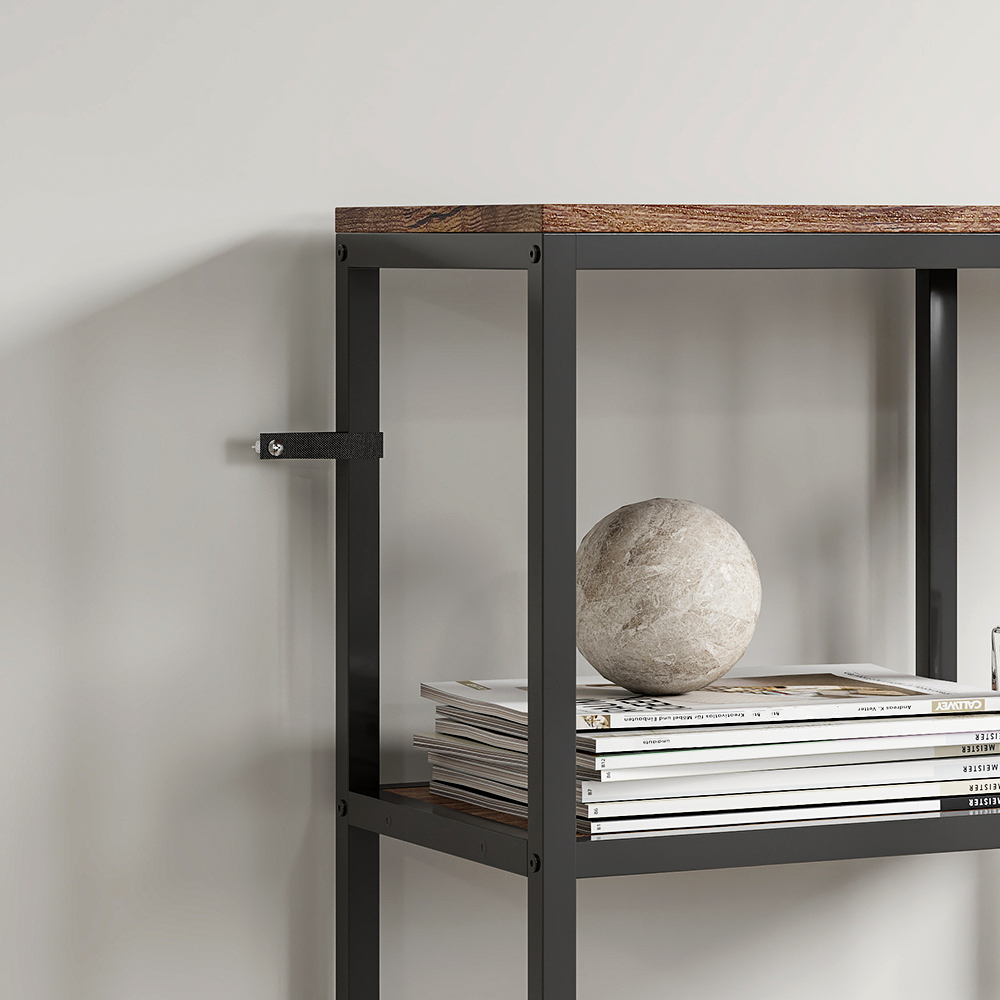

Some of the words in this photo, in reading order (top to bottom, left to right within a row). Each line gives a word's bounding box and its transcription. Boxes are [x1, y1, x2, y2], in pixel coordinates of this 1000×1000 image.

[934, 700, 983, 711] CALLWEY
[961, 744, 996, 753] MEISTER
[962, 763, 999, 773] MEISTER
